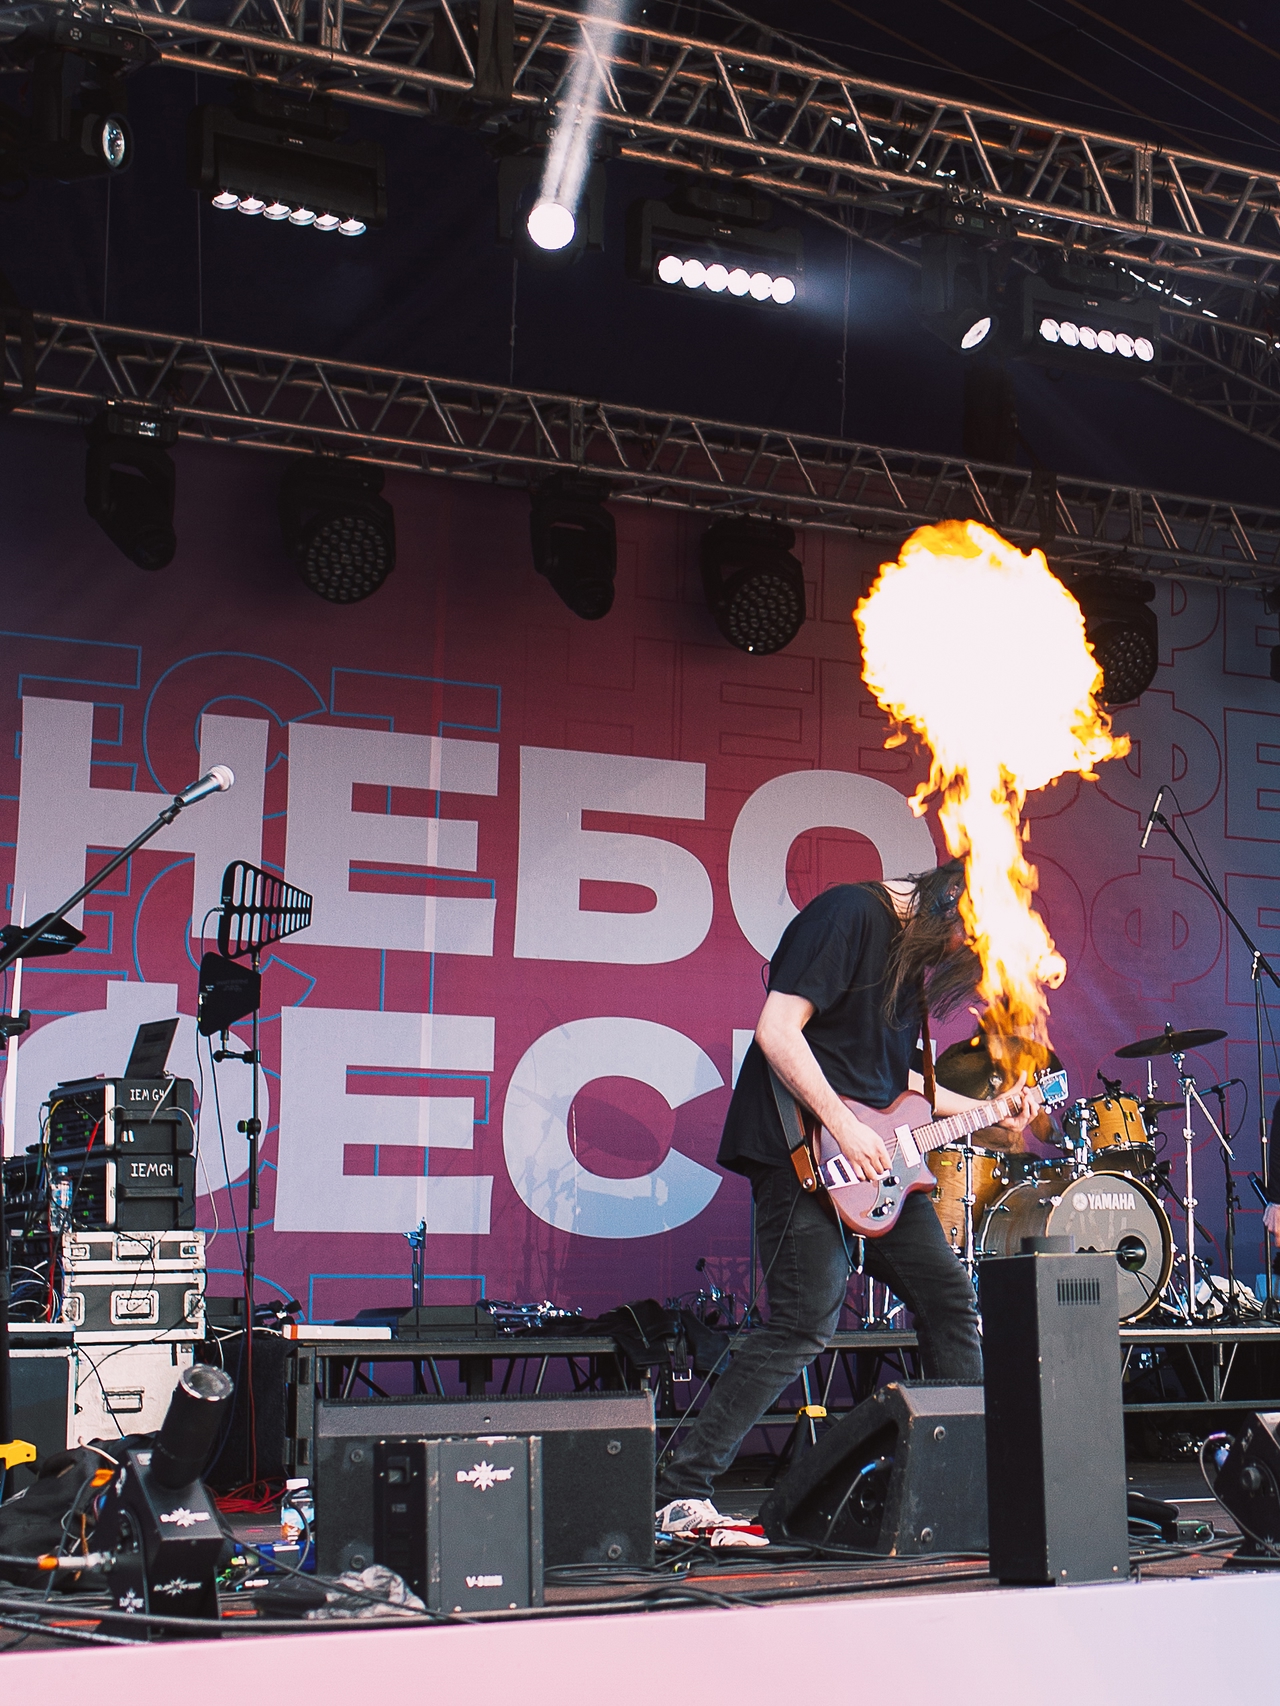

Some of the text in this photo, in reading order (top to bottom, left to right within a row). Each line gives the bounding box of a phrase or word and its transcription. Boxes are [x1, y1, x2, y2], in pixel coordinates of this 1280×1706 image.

[12, 696, 940, 968] НЕБО
[5, 979, 937, 1240] ФЕС
[1087, 1193, 1136, 1210] YAMAHA
